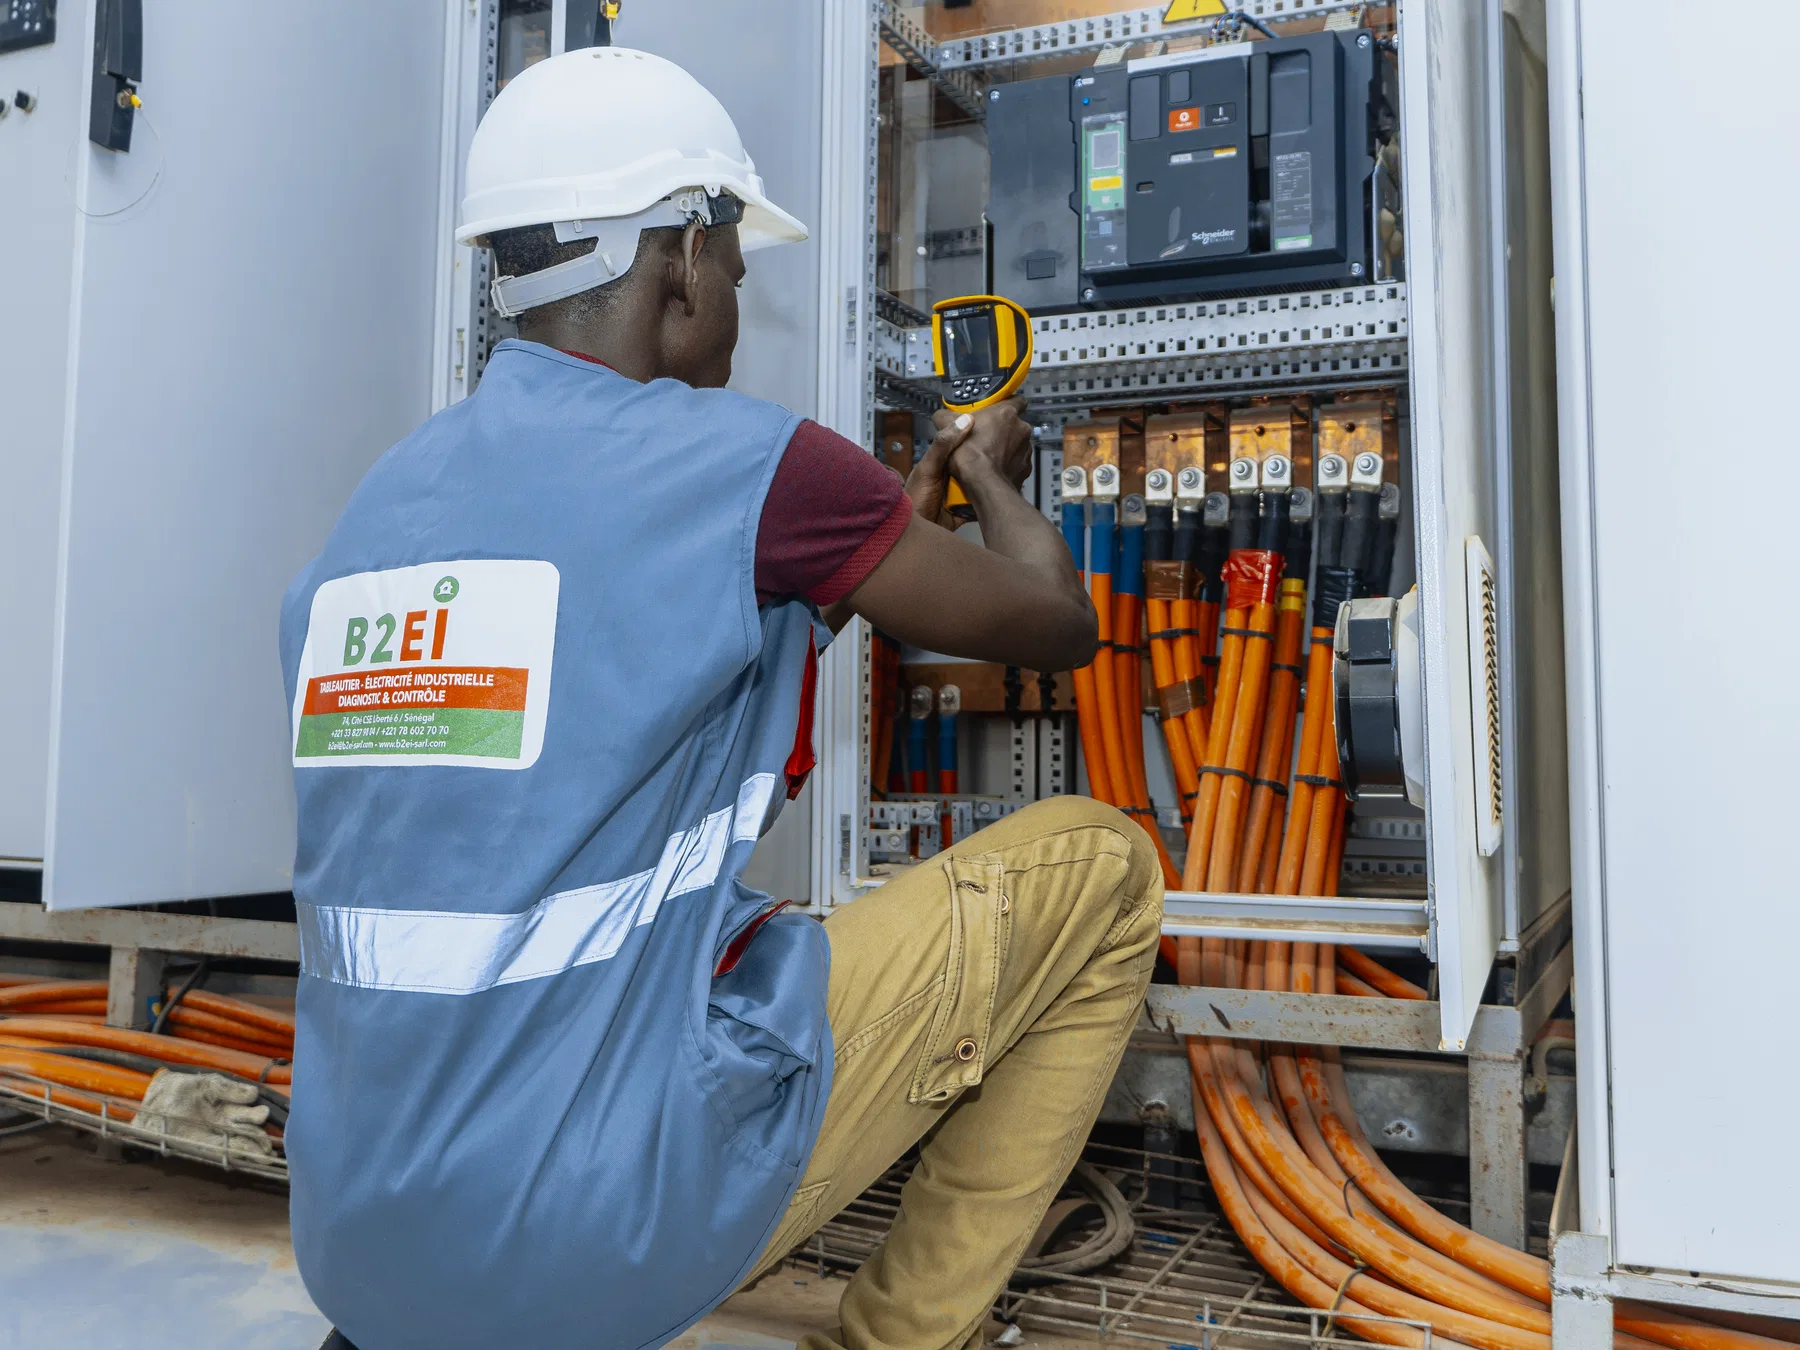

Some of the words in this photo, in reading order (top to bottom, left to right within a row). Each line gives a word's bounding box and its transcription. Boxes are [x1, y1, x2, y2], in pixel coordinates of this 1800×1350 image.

[1191, 228, 1236, 241] Schneider
[319, 678, 361, 694] TABLEAUTIER
[364, 671, 413, 690] ÉLECTRICITÉ
[413, 673, 495, 687] INDUSTRIELLE
[338, 691, 382, 708] DIAGNOSTIC
[382, 691, 391, 704] &
[391, 687, 447, 704] CONTRÔLE
[351, 715, 362, 725] Cité
[362, 715, 373, 724] CSE
[372, 713, 393, 724] Liberté
[393, 713, 399, 722] 6
[404, 712, 435, 724] Sénégal
[331, 729, 343, 738] +221
[344, 728, 351, 738] 33
[351, 727, 363, 737] 827
[381, 726, 397, 736] +221
[398, 725, 408, 736] 78
[409, 725, 425, 736] 602
[426, 725, 438, 735] 70
[439, 725, 450, 735] 70
[378, 738, 447, 749] www.b2ei-sarl.com
